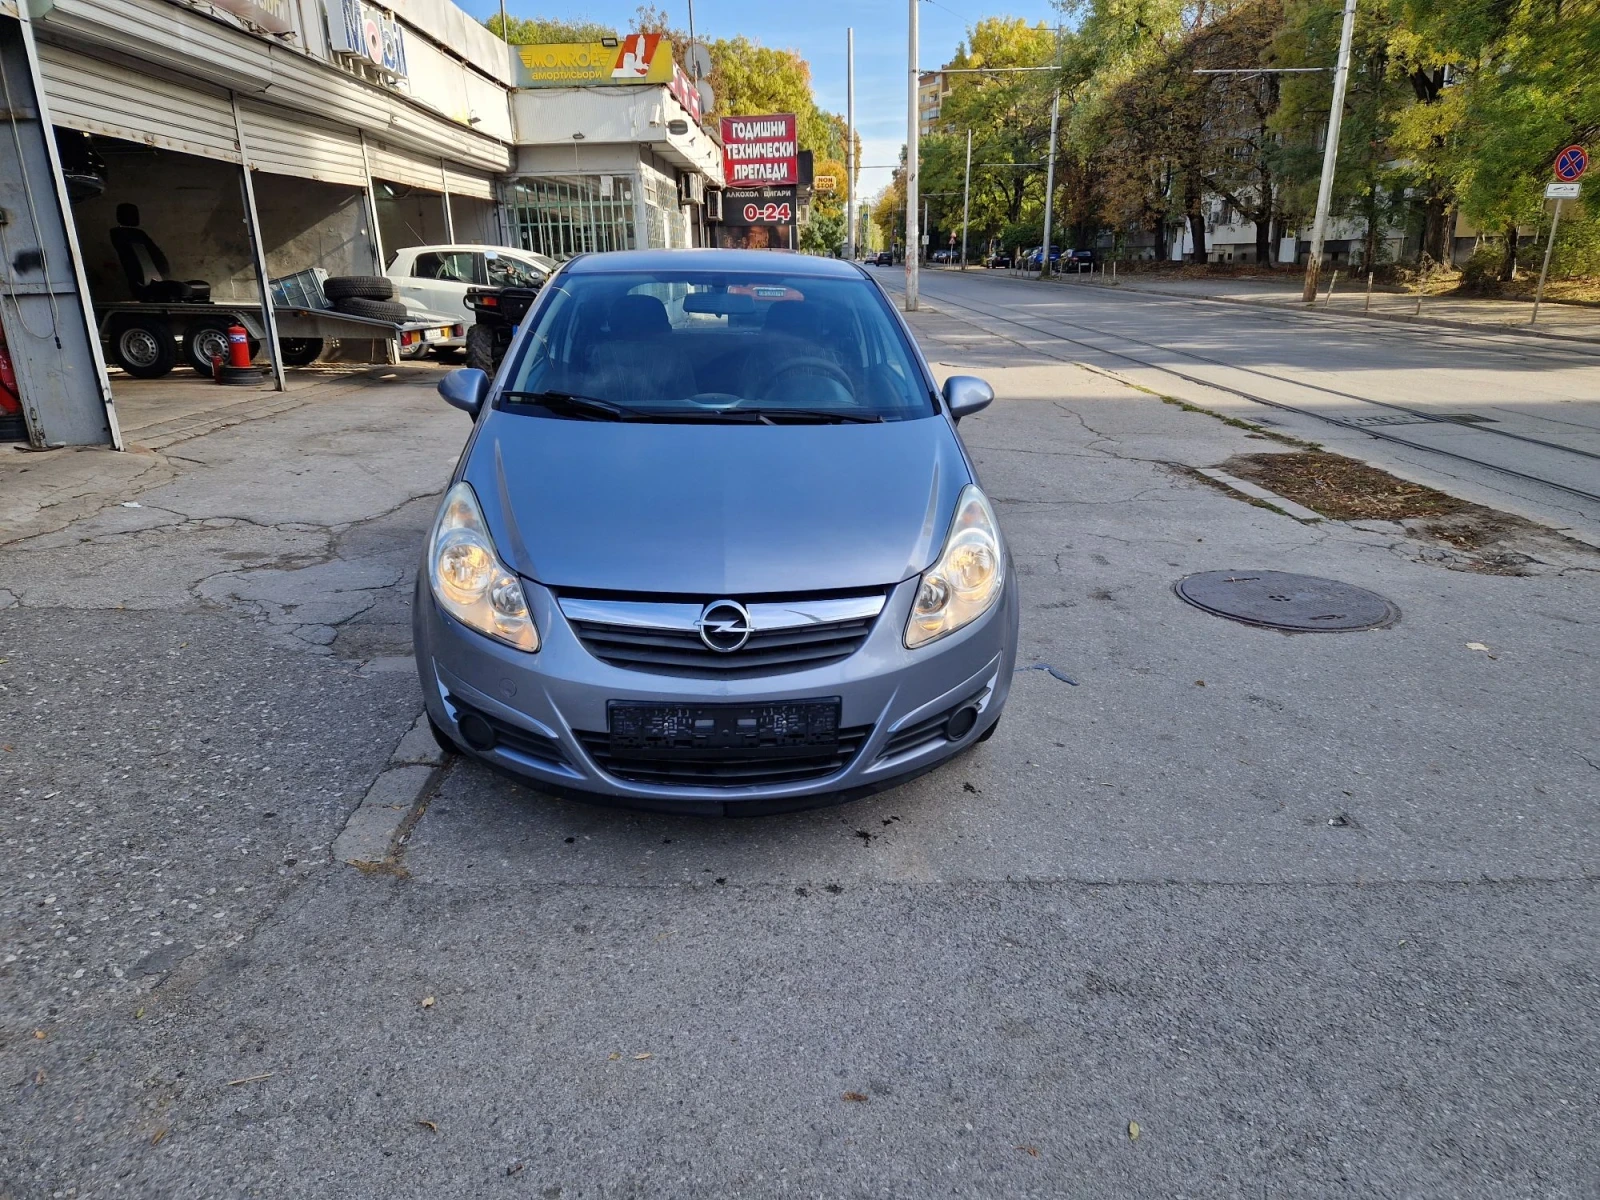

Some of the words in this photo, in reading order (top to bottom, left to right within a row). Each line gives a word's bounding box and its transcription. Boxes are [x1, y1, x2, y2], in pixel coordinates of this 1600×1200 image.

[342, 0, 408, 77] Mobil
[531, 50, 601, 69] MONROE
[532, 70, 602, 82] амортисьори
[732, 121, 786, 140] ГОДИШНИ
[726, 141, 794, 160] ТЕХНИЧЕСКИ
[734, 162, 788, 180] ПРЕГЛЕДИ
[763, 190, 791, 198] ЦИГАРИ
[743, 203, 791, 221] 0-24
